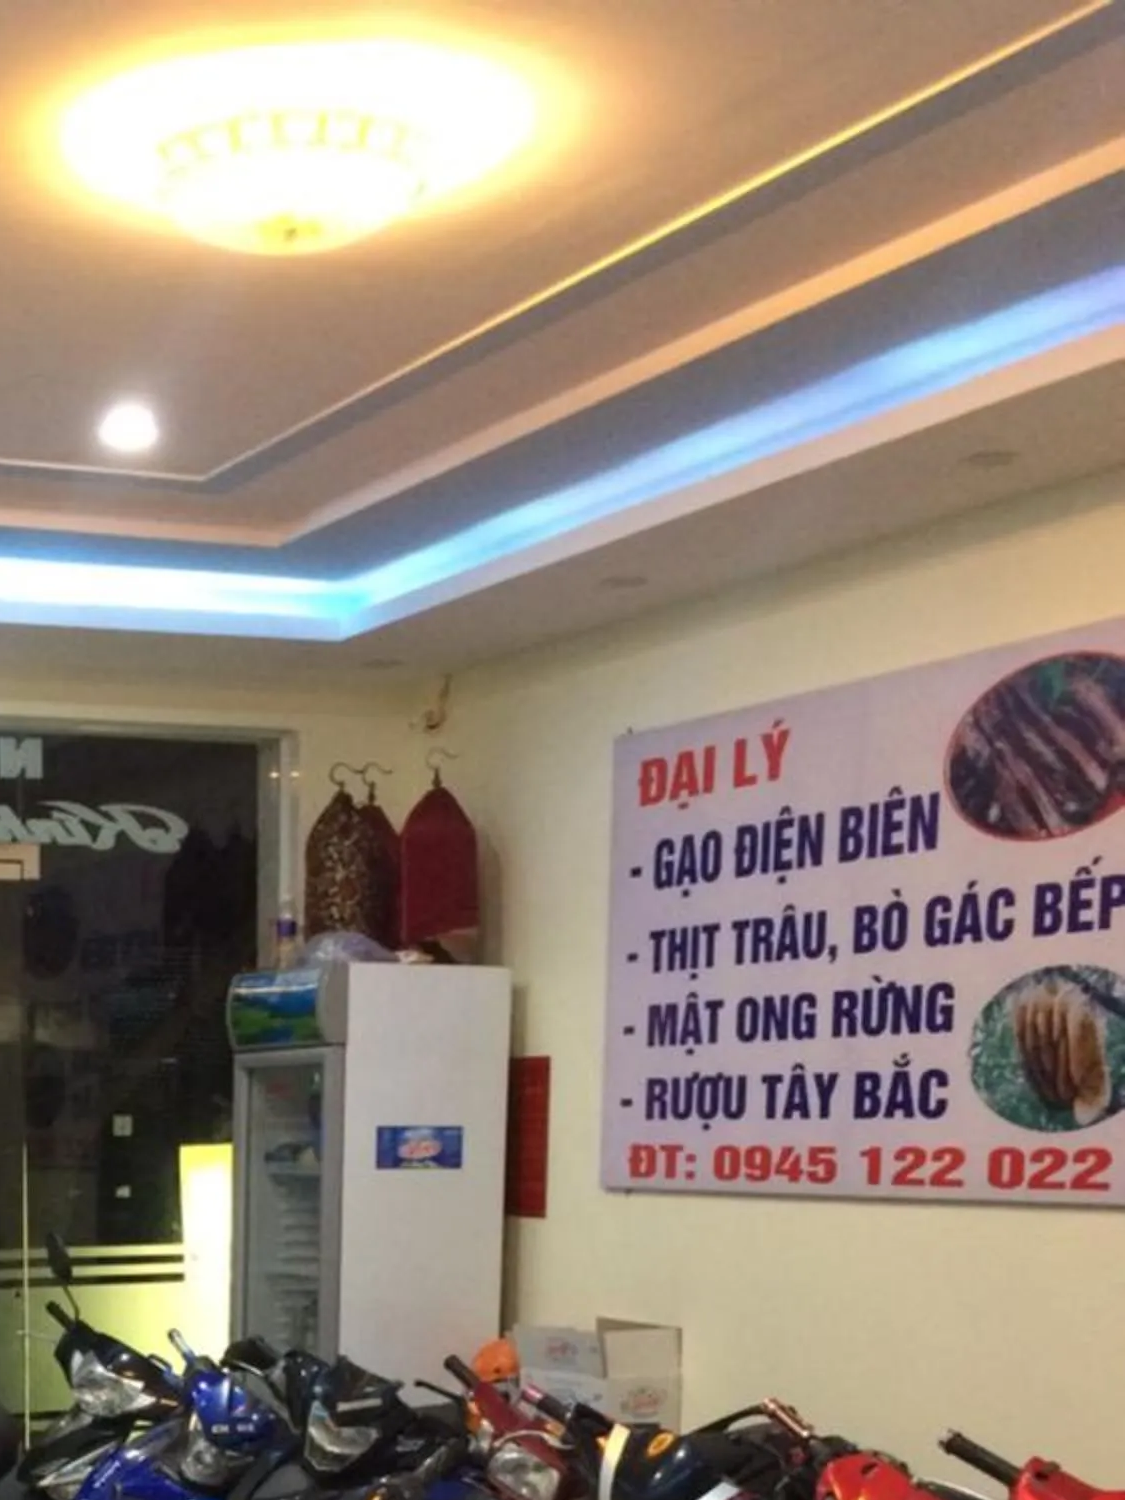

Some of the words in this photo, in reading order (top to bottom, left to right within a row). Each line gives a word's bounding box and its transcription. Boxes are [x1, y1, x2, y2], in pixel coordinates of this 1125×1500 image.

[638, 745, 716, 810] ĐẠI
[731, 718, 791, 790] LÝ
[653, 829, 723, 898] GẠO
[734, 807, 824, 885] ĐIỆN
[837, 785, 940, 863] BIÊN
[649, 922, 720, 981] THỊT
[731, 904, 838, 965] TRÂU,
[853, 888, 909, 954] BÒ
[924, 879, 1016, 947] GÁC
[1032, 855, 1125, 938] BẾP
[646, 992, 724, 1056] MẬT
[735, 992, 818, 1043] ONG
[831, 974, 956, 1039] RỪNG
[644, 1072, 747, 1131] RƯỢU
[761, 1063, 841, 1121] TÂY
[852, 1053, 950, 1120] BẮC
[628, 1144, 697, 1180] ĐT:
[712, 1143, 838, 1186] 0945
[859, 1145, 967, 1189] 122
[986, 1147, 1114, 1192] 022
